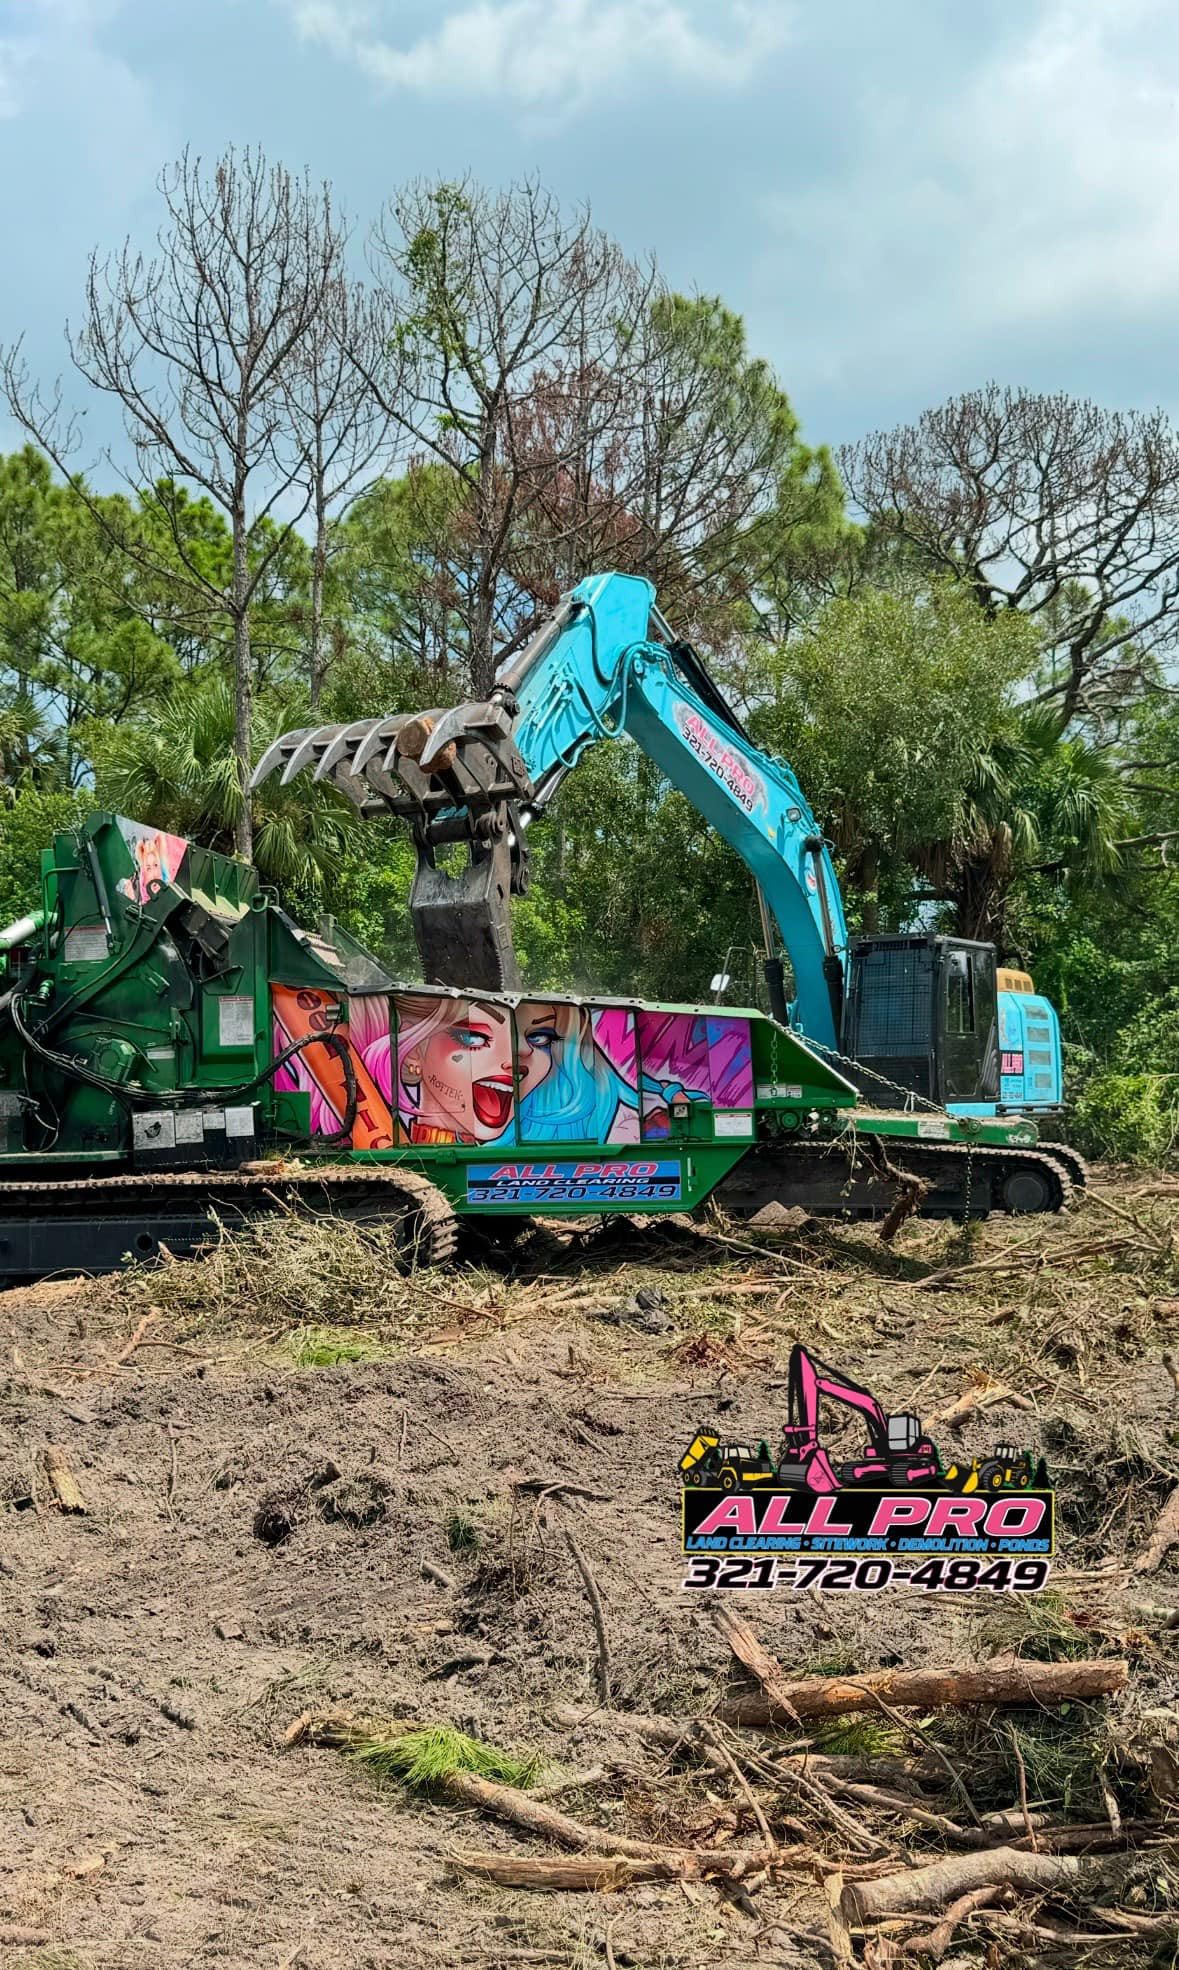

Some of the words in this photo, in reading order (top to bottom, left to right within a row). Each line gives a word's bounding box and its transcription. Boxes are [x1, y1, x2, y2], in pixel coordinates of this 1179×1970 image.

[685, 715, 719, 755] ALL
[720, 751, 755, 796] PRO
[682, 724, 754, 812] 321-720-4849
[489, 1164, 564, 1180] ALL
[569, 1162, 658, 1178] PRO
[496, 1178, 549, 1187] LAND
[552, 1177, 650, 1186] CLEARING
[472, 1184, 676, 1201] 321-720-4849
